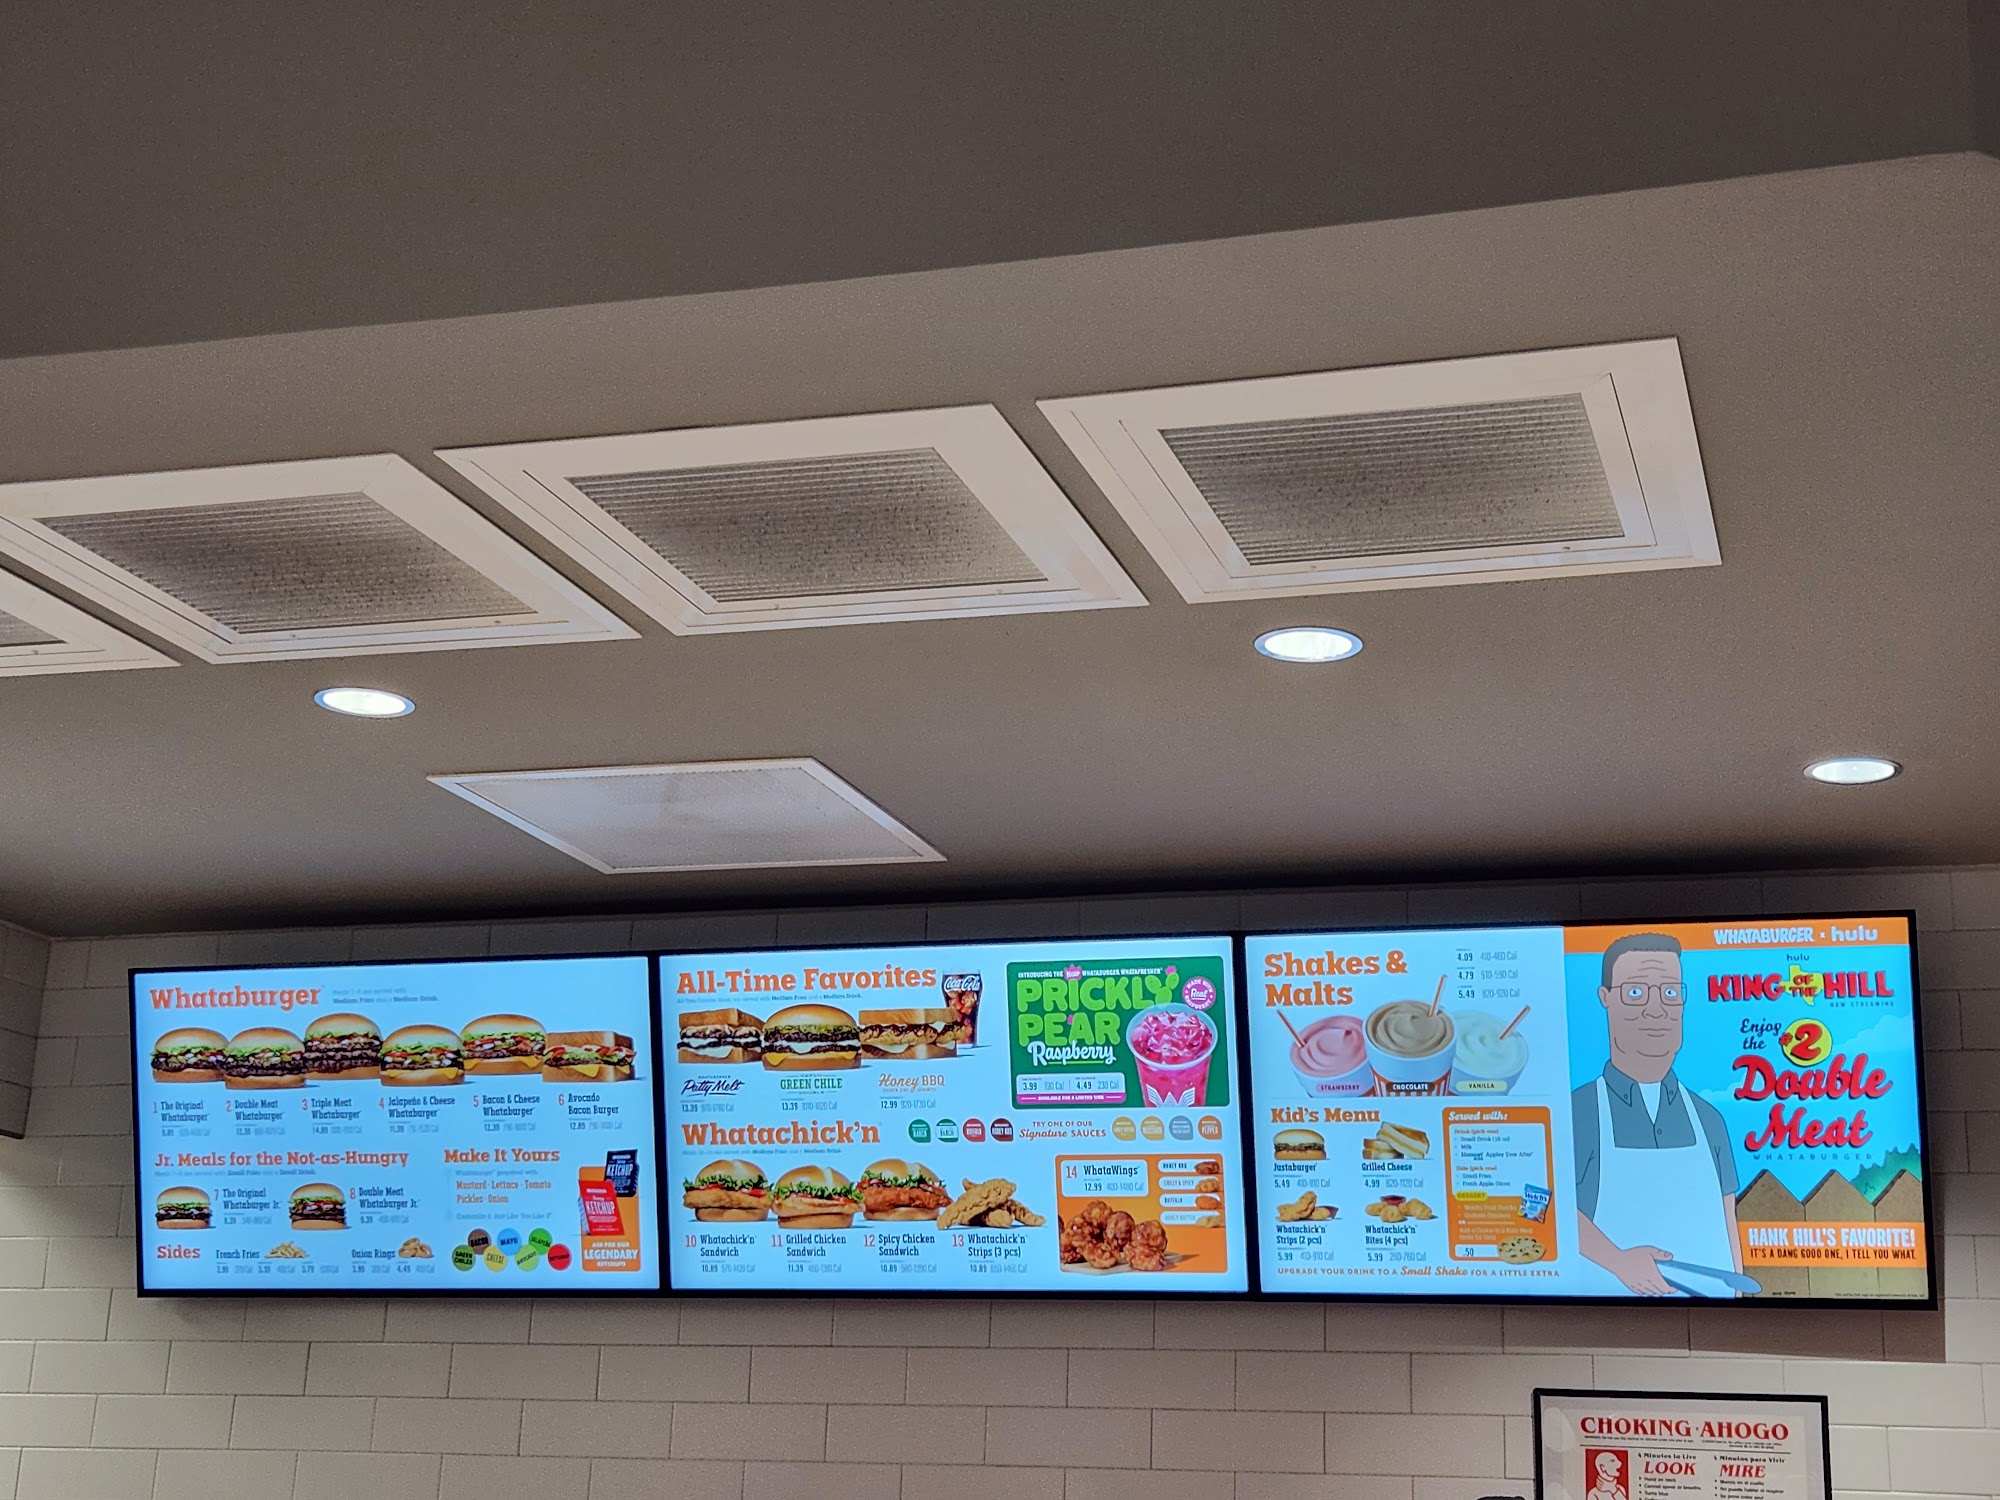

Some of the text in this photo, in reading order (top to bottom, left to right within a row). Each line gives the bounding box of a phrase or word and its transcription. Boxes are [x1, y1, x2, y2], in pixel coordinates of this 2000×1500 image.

[1714, 926, 1878, 944] WHATABURGER hulu
[1264, 950, 1408, 977] Shakes &
[1457, 953, 1473, 961] 4.09
[1786, 953, 1810, 961] hulu
[677, 964, 937, 994] All-Time Favorites
[1017, 972, 1180, 1012] PRICKLY
[1708, 971, 1894, 1002] KING OF THE HILL
[151, 985, 321, 1011] Whataburger
[1265, 981, 1353, 1007] Malts
[1018, 1012, 1120, 1047] PEAR
[1740, 1018, 1782, 1036] Enjoy
[1743, 1036, 1766, 1049] the
[1027, 1041, 1116, 1066] Raspberry
[879, 1073, 944, 1093] Honey BBQ
[1733, 1053, 1893, 1100] Double
[680, 1079, 745, 1097] Patty Melt
[780, 1078, 842, 1090] GREEN CHILE
[1392, 1083, 1428, 1091] CHOCOLATE
[226, 1099, 278, 1111] 2 Double Meat
[302, 1097, 352, 1110] 3 Triple Meat
[379, 1097, 384, 1109] 4
[430, 1095, 455, 1105] Cheese
[473, 1094, 540, 1107] 5 Bacon Cheese
[558, 1093, 600, 1106] 6 Avocado
[153, 1100, 203, 1113] 1 The Original
[389, 1107, 437, 1119] Whataburger
[483, 1106, 533, 1118] Whataburger
[568, 1104, 619, 1115] Bacon Burger
[161, 1112, 208, 1123] Whataburger
[236, 1111, 283, 1122] Whataburger
[312, 1109, 360, 1120] Whataburger
[1271, 1108, 1380, 1123] Kid's Menu
[1448, 1111, 1508, 1120] Served with:
[682, 1120, 880, 1146] Whatachick'n
[1744, 1103, 1873, 1151] Meat
[1019, 1128, 1068, 1142] Signature
[1071, 1128, 1107, 1137] SAUCES
[155, 1150, 409, 1168] Jr. Meals for the Not-as-Hungry
[444, 1149, 560, 1163] Make It Yours
[607, 1163, 634, 1177] KETCHUP
[1065, 1165, 1138, 1178] 14 WhataWings
[1273, 1163, 1317, 1173] Justaburger
[1362, 1162, 1412, 1171] Grilled Cheese
[456, 1180, 551, 1190] Mustard Lettuce Tomato
[214, 1188, 266, 1201] 7 The Original
[350, 1187, 403, 1199] 8 Double Meat
[457, 1194, 509, 1203] Pickles Onion
[585, 1201, 616, 1215] KETCHUP
[1276, 1225, 1326, 1234] Whatachick'n
[1365, 1225, 1416, 1234] Whatachick'n
[686, 1234, 755, 1247] 10 Whatachick'n
[772, 1234, 847, 1247] 11 Grilled Chicken
[864, 1234, 935, 1247] 12 Spicy Chicken
[952, 1234, 1026, 1247] 13 Whatachick'n
[1277, 1236, 1322, 1245] Strips (2 pcs)
[1366, 1236, 1408, 1245] Bites (4 pcs)
[1749, 1228, 1915, 1247] HANK HILL'S FAVORITE!
[157, 1246, 201, 1259] Sides
[216, 1249, 260, 1258] French Fries
[352, 1249, 395, 1260] Onion Rings
[584, 1249, 638, 1259] LEGENDARY
[700, 1247, 739, 1257] Sandwich
[787, 1247, 826, 1257] Sandwich
[879, 1246, 919, 1256] Sandwich
[968, 1246, 1021, 1258] Strips (3 pcs)
[1750, 1249, 1766, 1258] IT'S
[1770, 1249, 1775, 1258] A
[1777, 1249, 1798, 1258] DANG
[1801, 1249, 1821, 1259] GOOD
[1825, 1249, 1843, 1260] ONE,
[1853, 1249, 1870, 1259] TELL
[1874, 1249, 1888, 1259] YOU
[1892, 1249, 1916, 1259] WHAT.
[1401, 1266, 1431, 1276] Small
[1435, 1266, 1468, 1276] Shake
[1580, 1416, 1691, 1436] CHOKING
[1700, 1421, 1789, 1440] AHOGO
[1644, 1460, 1696, 1475] LOOK
[1719, 1464, 1766, 1478] MIRE
